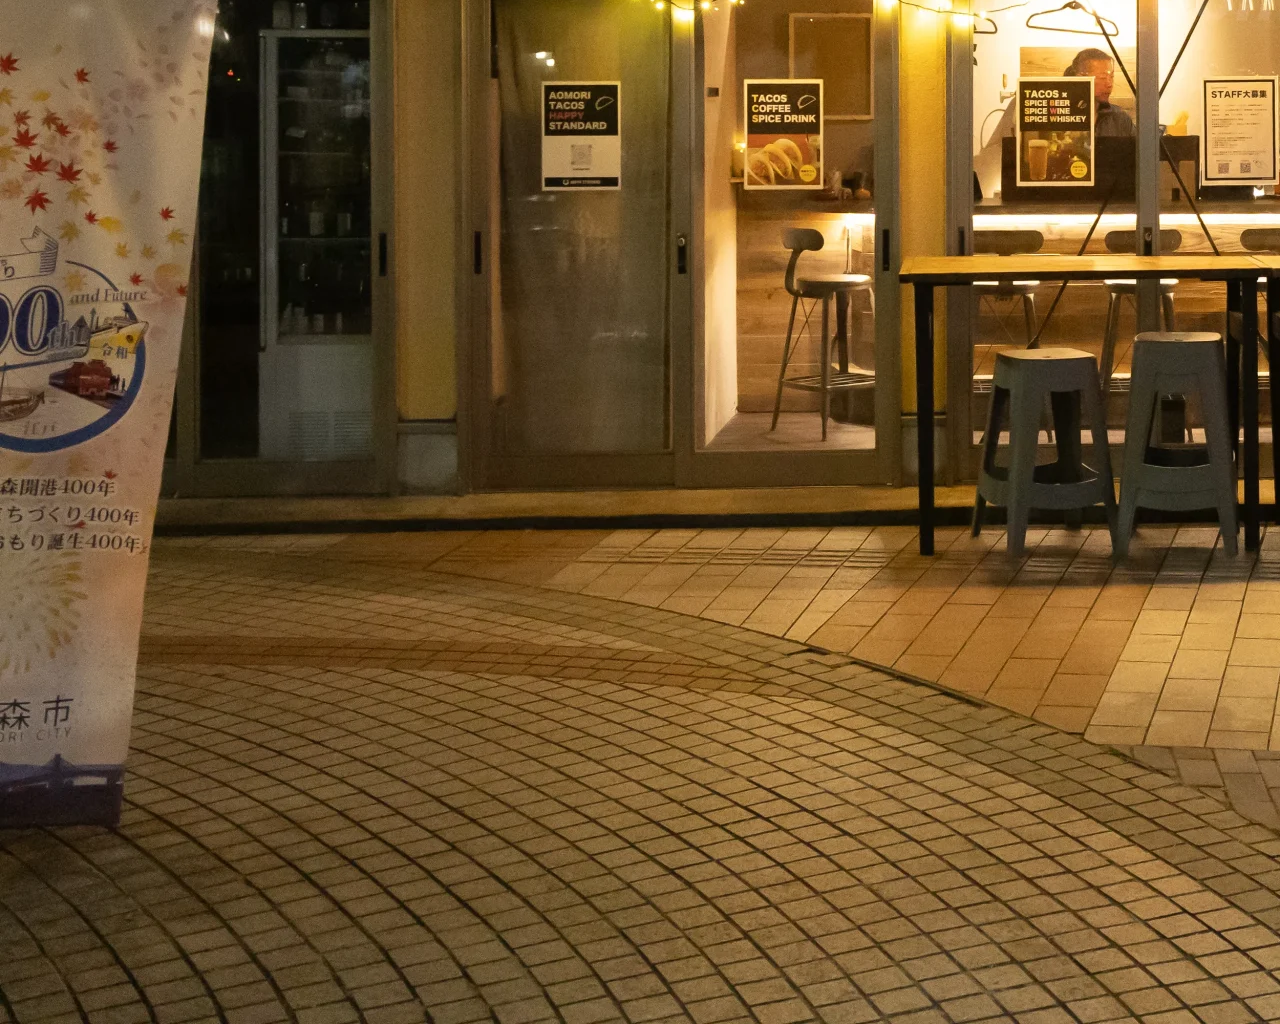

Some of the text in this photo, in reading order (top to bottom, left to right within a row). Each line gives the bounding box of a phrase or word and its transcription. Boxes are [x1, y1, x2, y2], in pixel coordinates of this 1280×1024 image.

[549, 91, 591, 100] AOMORI
[752, 94, 787, 103] TACOS
[1024, 90, 1059, 98] TACOS
[549, 101, 585, 110] TACOS
[1024, 99, 1070, 107] SPICE BEER
[752, 104, 791, 113] COFFEE
[1024, 107, 1070, 115] SPICE WINE
[549, 111, 584, 120] HAPPY
[752, 114, 816, 123] SPICE DRINK
[1024, 115, 1086, 123] SPICE WHISKEY
[549, 121, 607, 130] STANDARD
[70, 288, 148, 305] and Future
[0, 505, 140, 526] ちづくり400年
[37, 727, 71, 740] CITY
